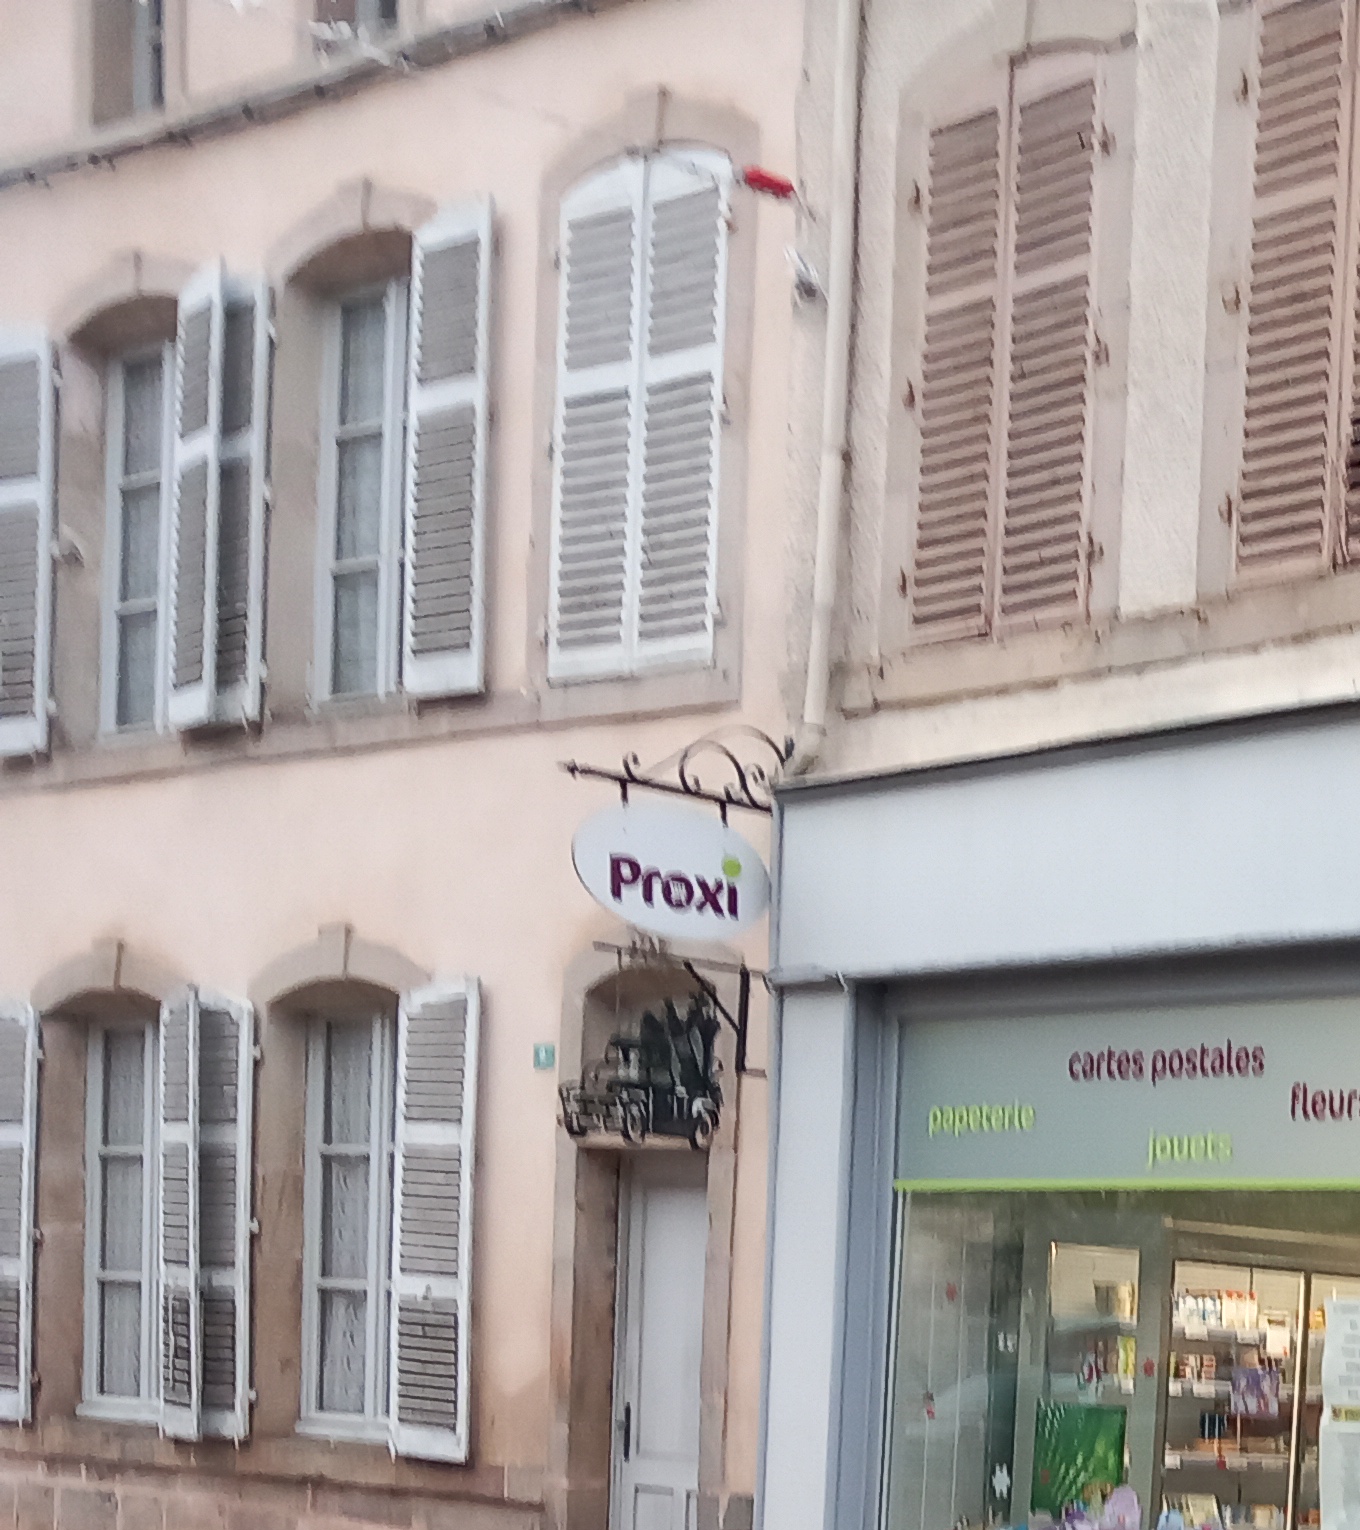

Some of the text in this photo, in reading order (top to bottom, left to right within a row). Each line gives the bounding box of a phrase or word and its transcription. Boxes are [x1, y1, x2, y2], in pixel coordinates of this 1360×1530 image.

[609, 852, 742, 920] Proxi
[1068, 1037, 1266, 1088] cartes postales
[928, 1097, 1036, 1138] papeterie
[1147, 1127, 1233, 1169] jouets
